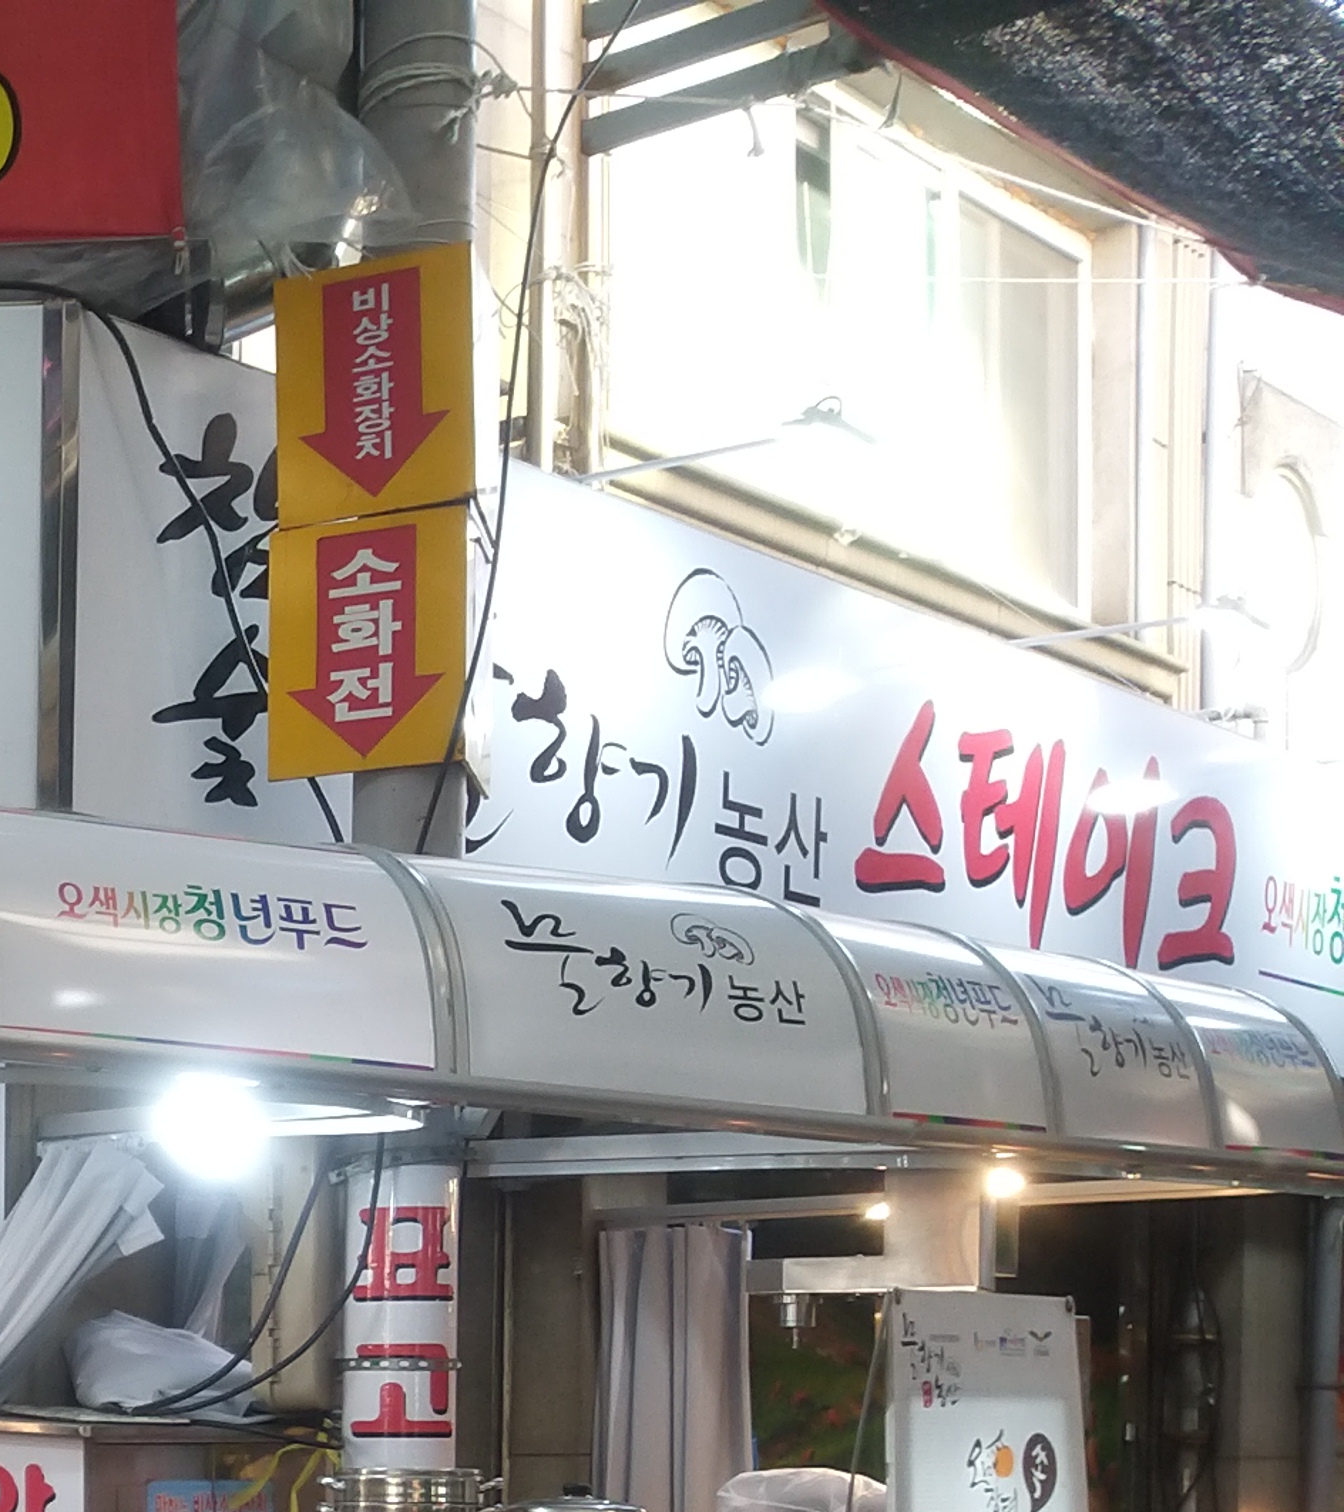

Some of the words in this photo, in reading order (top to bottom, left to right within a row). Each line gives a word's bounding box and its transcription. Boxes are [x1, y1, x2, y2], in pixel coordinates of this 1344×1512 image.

[352, 282, 394, 460] 비상소화장치
[326, 547, 402, 724] 소화전
[855, 698, 1239, 972] 스테이크
